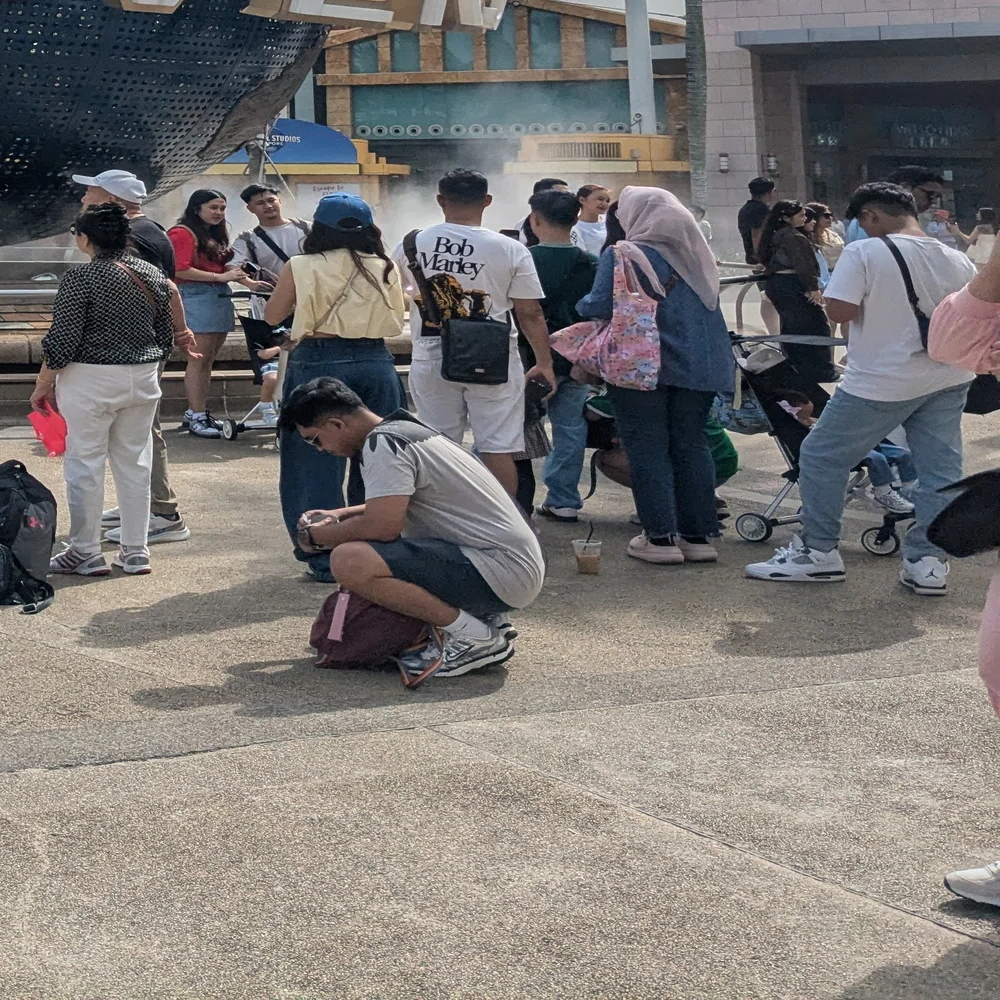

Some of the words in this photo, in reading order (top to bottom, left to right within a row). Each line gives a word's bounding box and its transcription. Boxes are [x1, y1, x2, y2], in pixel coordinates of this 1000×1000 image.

[271, 135, 301, 143] STUDIOS
[432, 236, 475, 258] Bob
[419, 252, 486, 281] Marley
